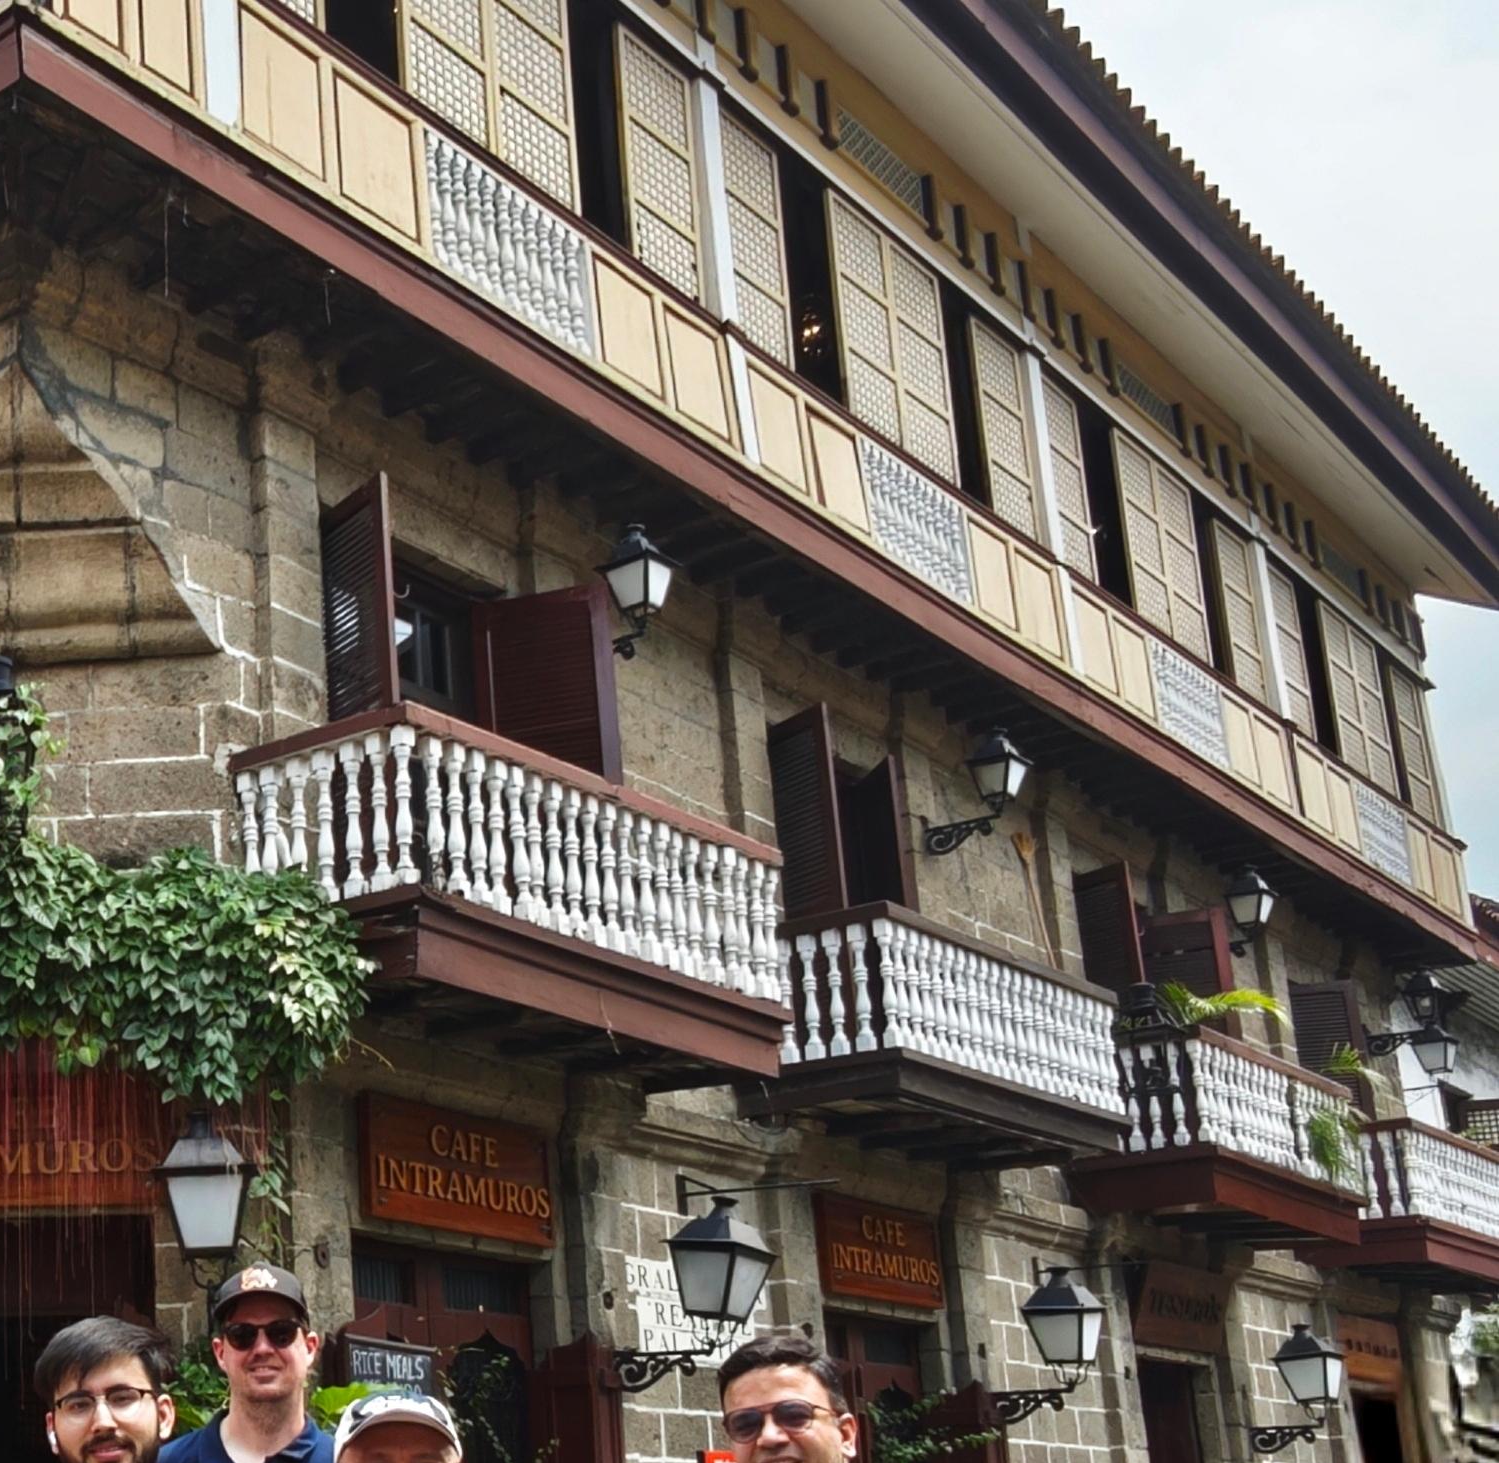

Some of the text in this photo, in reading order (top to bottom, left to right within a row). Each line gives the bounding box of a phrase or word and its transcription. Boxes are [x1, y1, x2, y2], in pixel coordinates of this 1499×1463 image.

[431, 1124, 499, 1168] CAFE
[377, 1152, 550, 1218] INTRAMUROS
[862, 1215, 906, 1247] CAFE
[832, 1243, 940, 1286] INTRAMUROS
[353, 1350, 425, 1381] RICE MEALS
